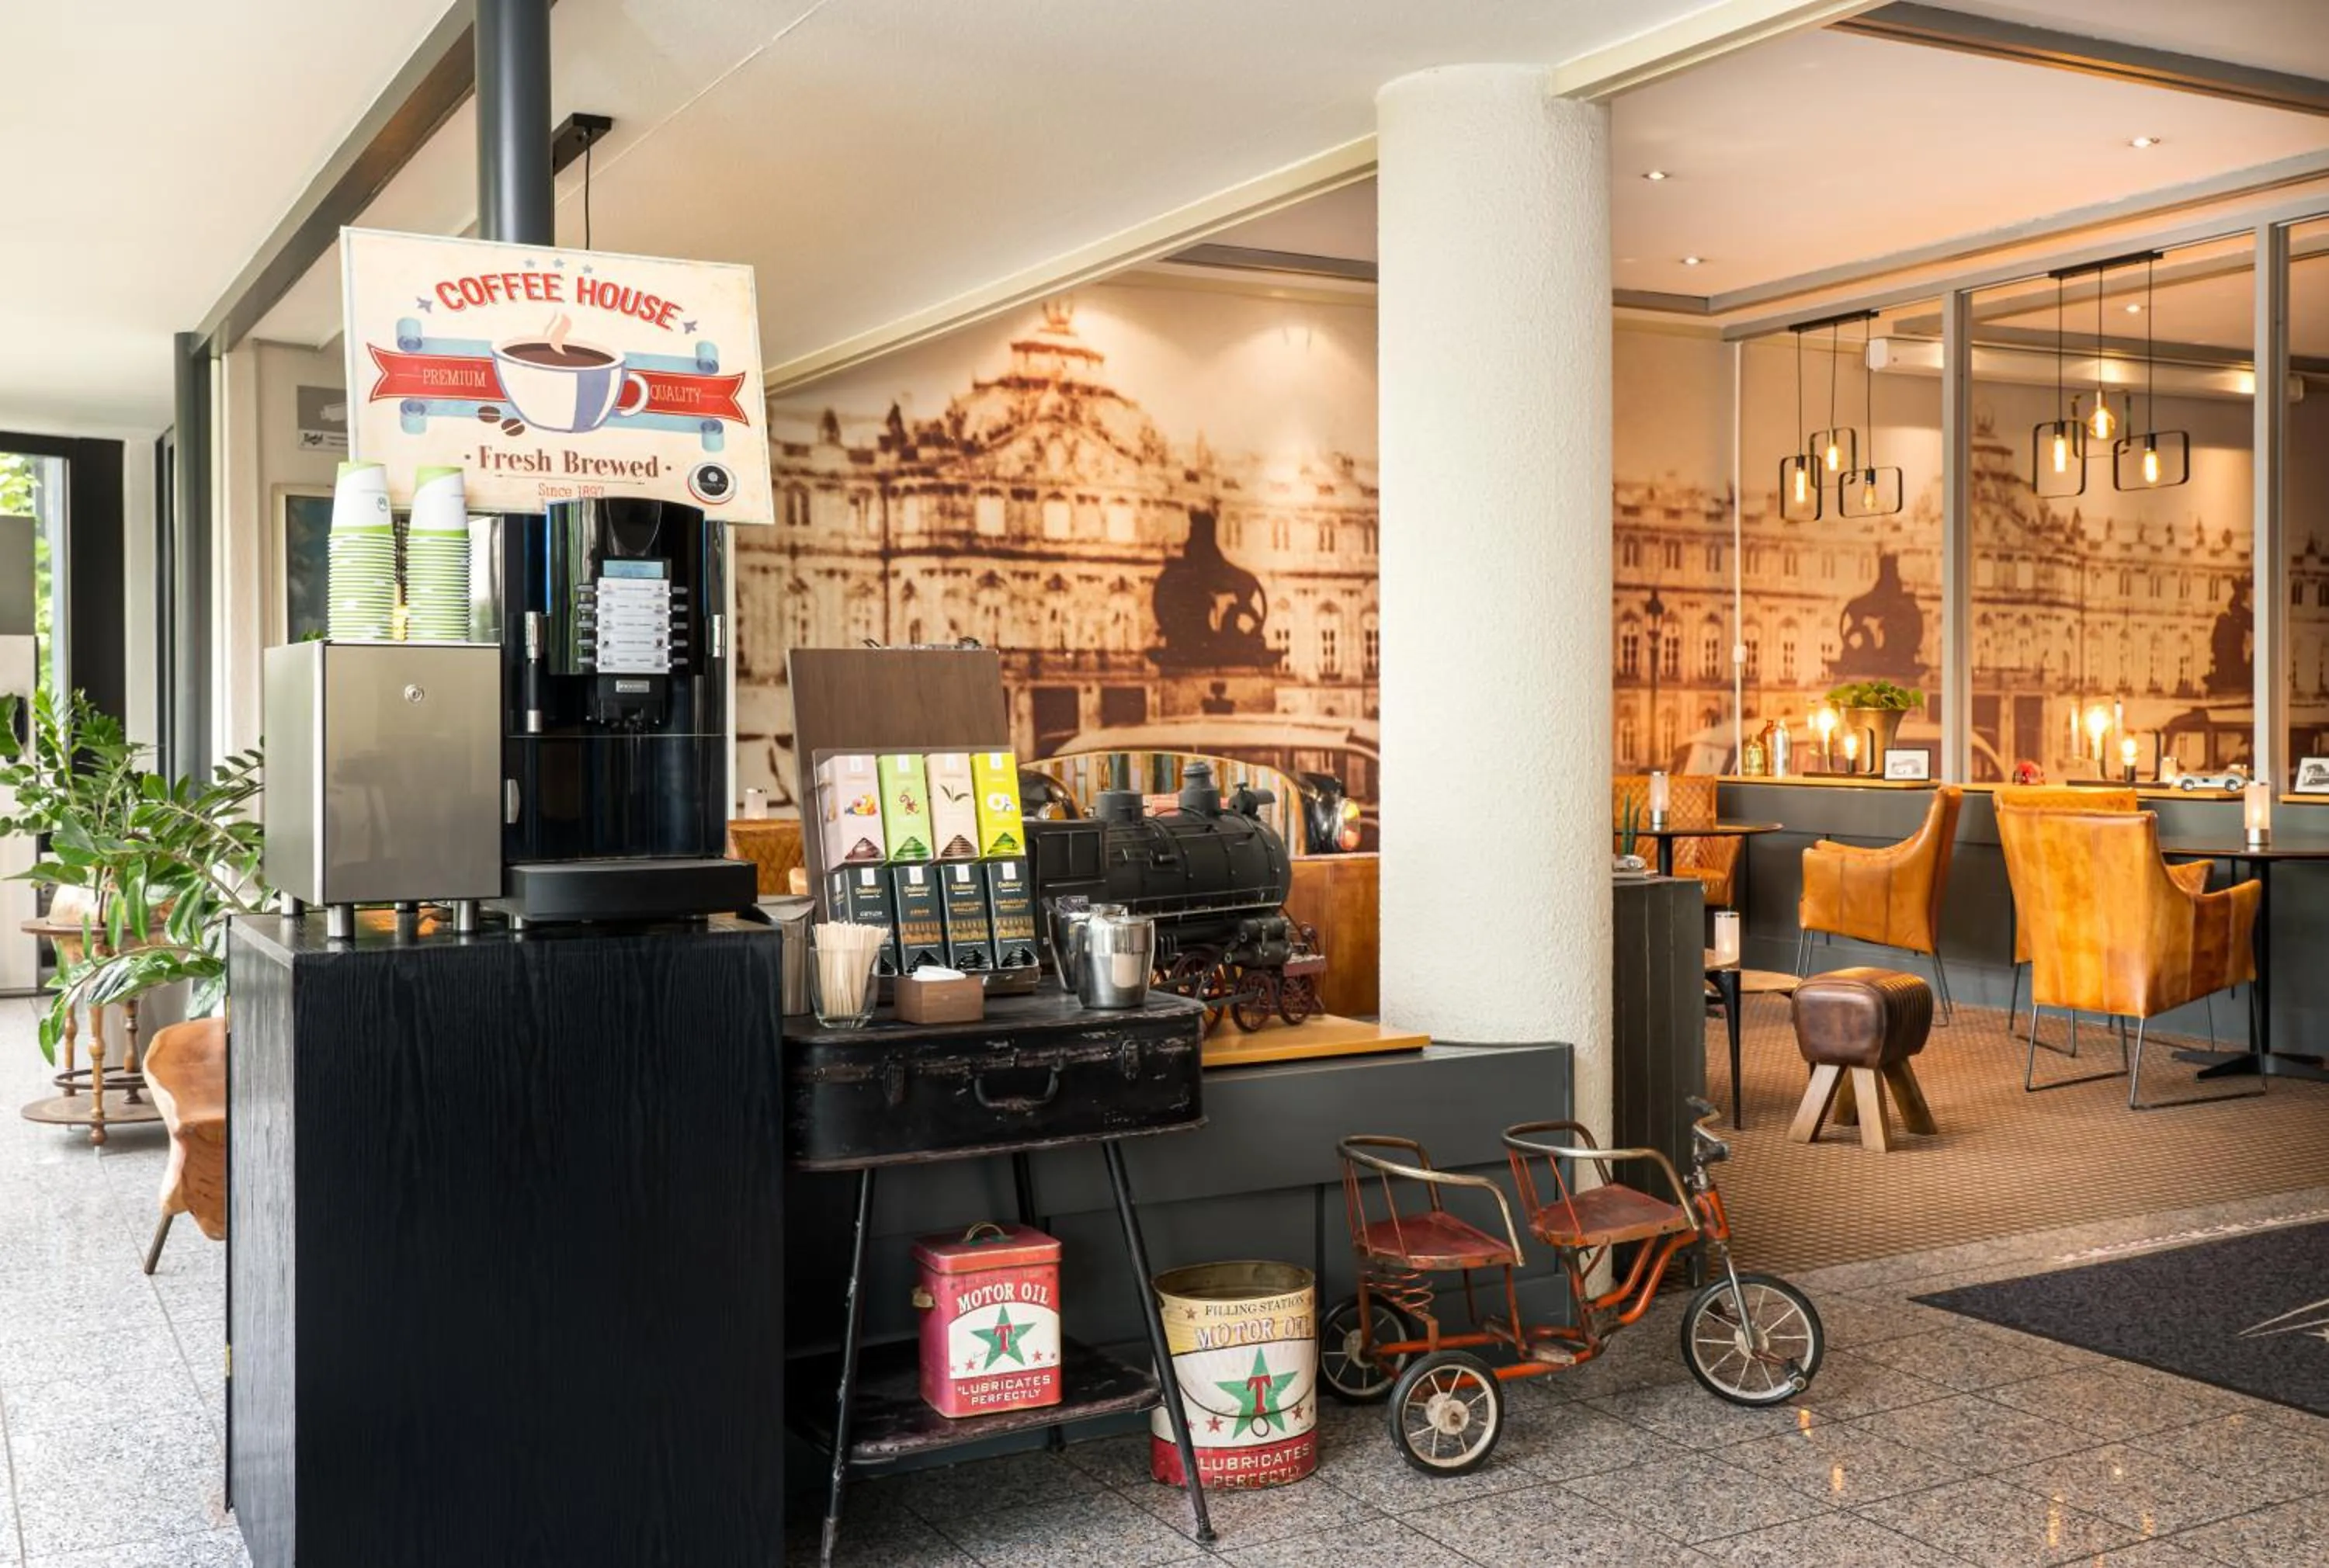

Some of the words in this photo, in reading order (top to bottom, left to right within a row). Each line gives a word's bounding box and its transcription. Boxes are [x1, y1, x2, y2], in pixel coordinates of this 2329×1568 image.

[435, 272, 565, 311] COFFEE
[576, 276, 684, 331] HOUSE
[422, 369, 487, 387] PREMIUM
[650, 384, 702, 404] QUALITY
[477, 445, 552, 473] Fresh
[564, 449, 659, 478] Brewed
[538, 482, 572, 498] Since
[956, 1282, 1017, 1313] MOTOR
[1021, 1282, 1050, 1305] OIL
[1205, 1304, 1257, 1316] FILLING
[1258, 1293, 1304, 1313] STATION
[994, 1322, 1014, 1354] T
[1196, 1318, 1276, 1349] MOTOR
[971, 1389, 1041, 1406] PERFECTLY
[1247, 1375, 1272, 1414] T
[1213, 1465, 1301, 1488] PERFECTLY
